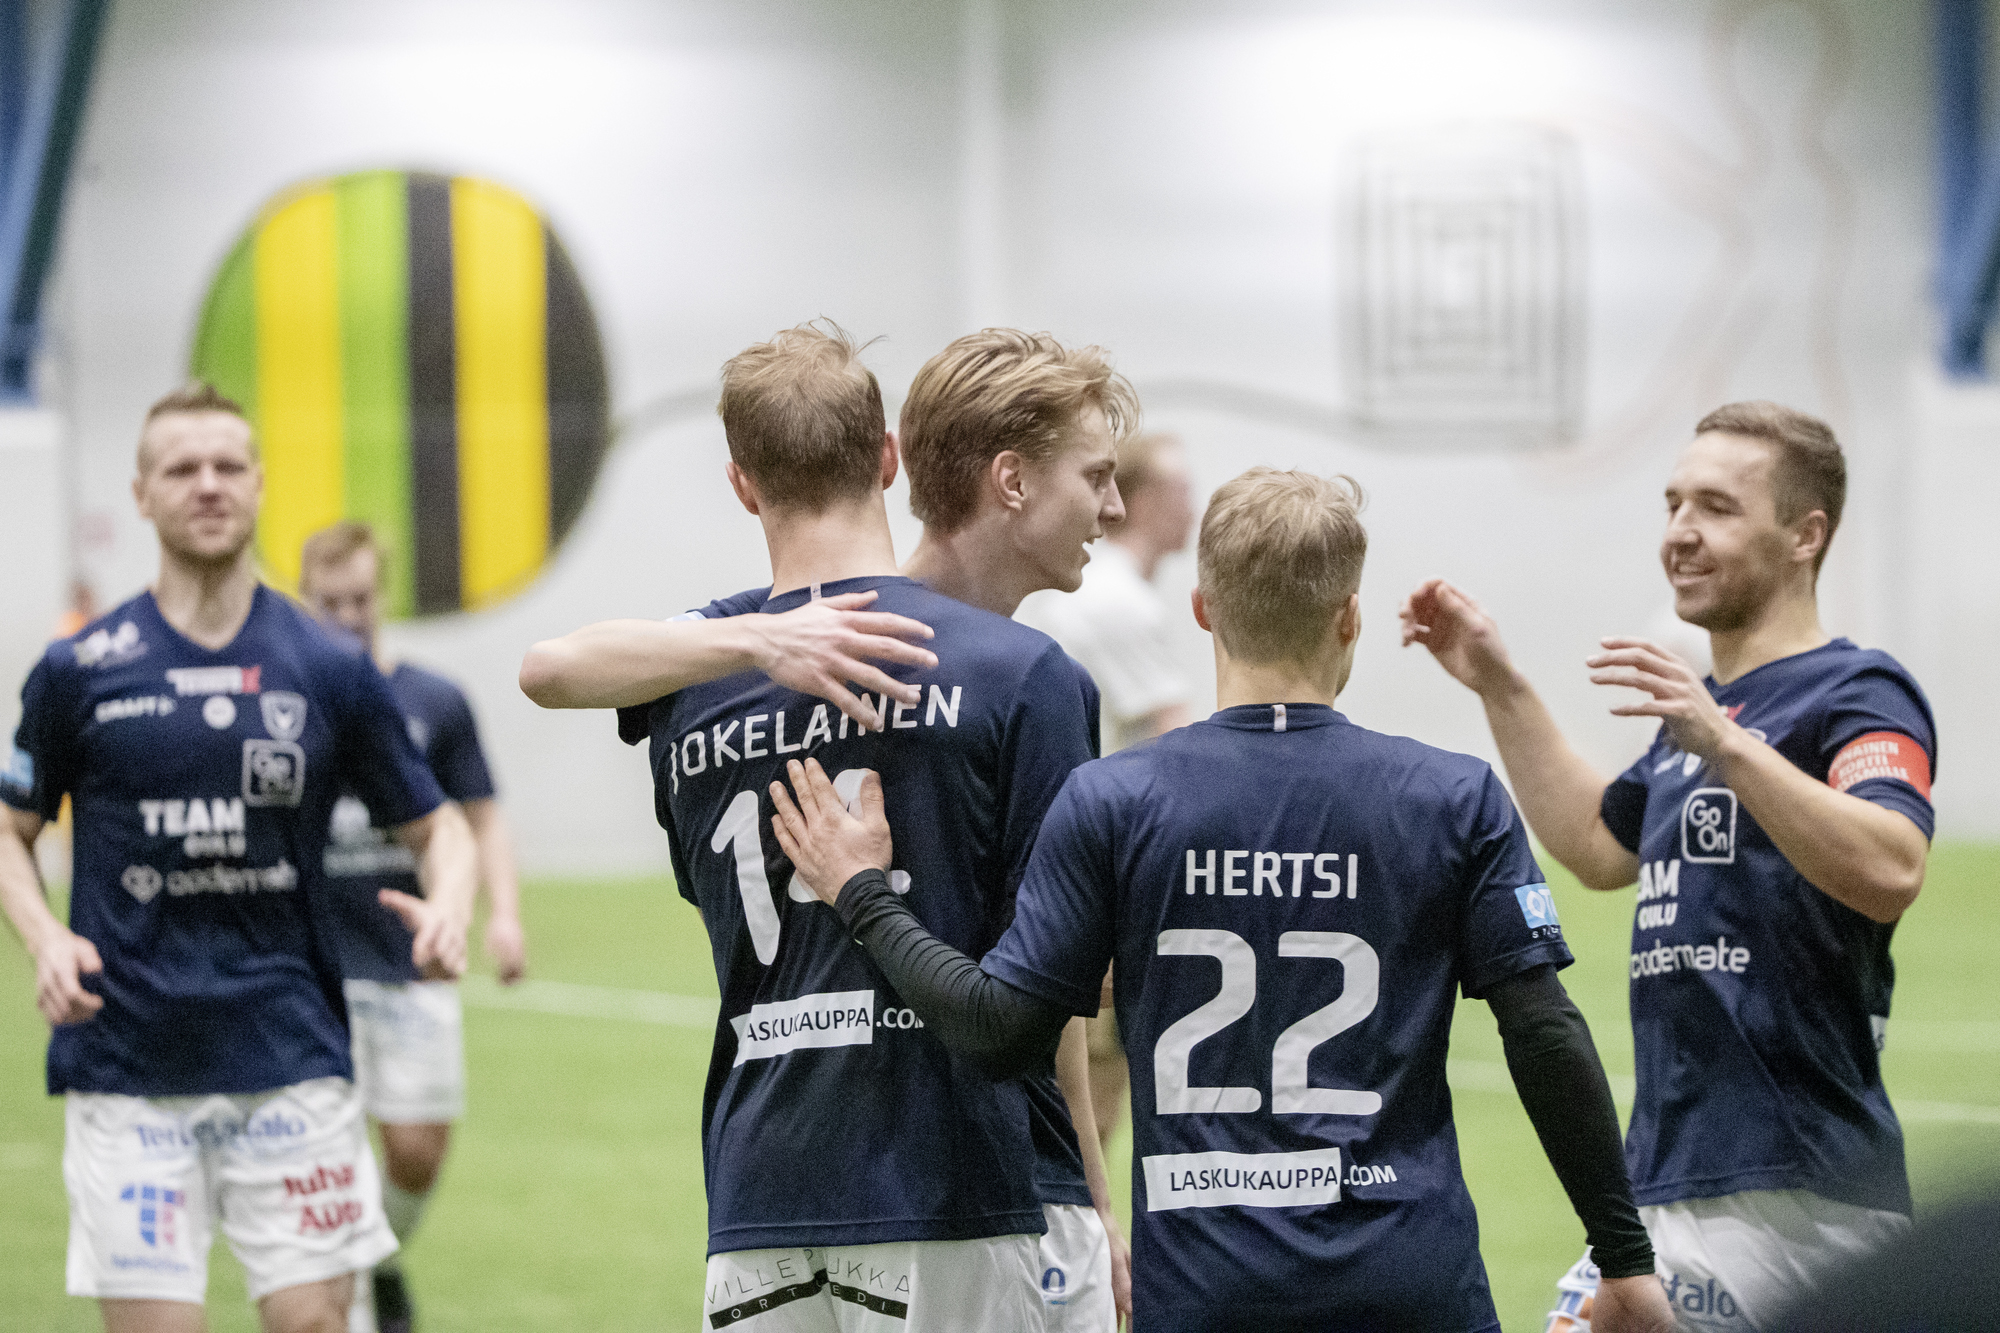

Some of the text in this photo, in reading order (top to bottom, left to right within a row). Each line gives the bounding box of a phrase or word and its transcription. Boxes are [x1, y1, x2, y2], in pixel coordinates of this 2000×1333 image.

[138, 798, 245, 836] TEAM
[1688, 799, 1722, 827] Go
[1698, 824, 1729, 852] On
[1185, 849, 1358, 899] HERTSI
[1636, 859, 1681, 901] AM
[1638, 902, 1678, 931] OULU
[1629, 936, 1751, 979] codemate
[747, 1007, 925, 1042] ASKUKAUPPA.CO
[1154, 929, 1383, 1115] 22
